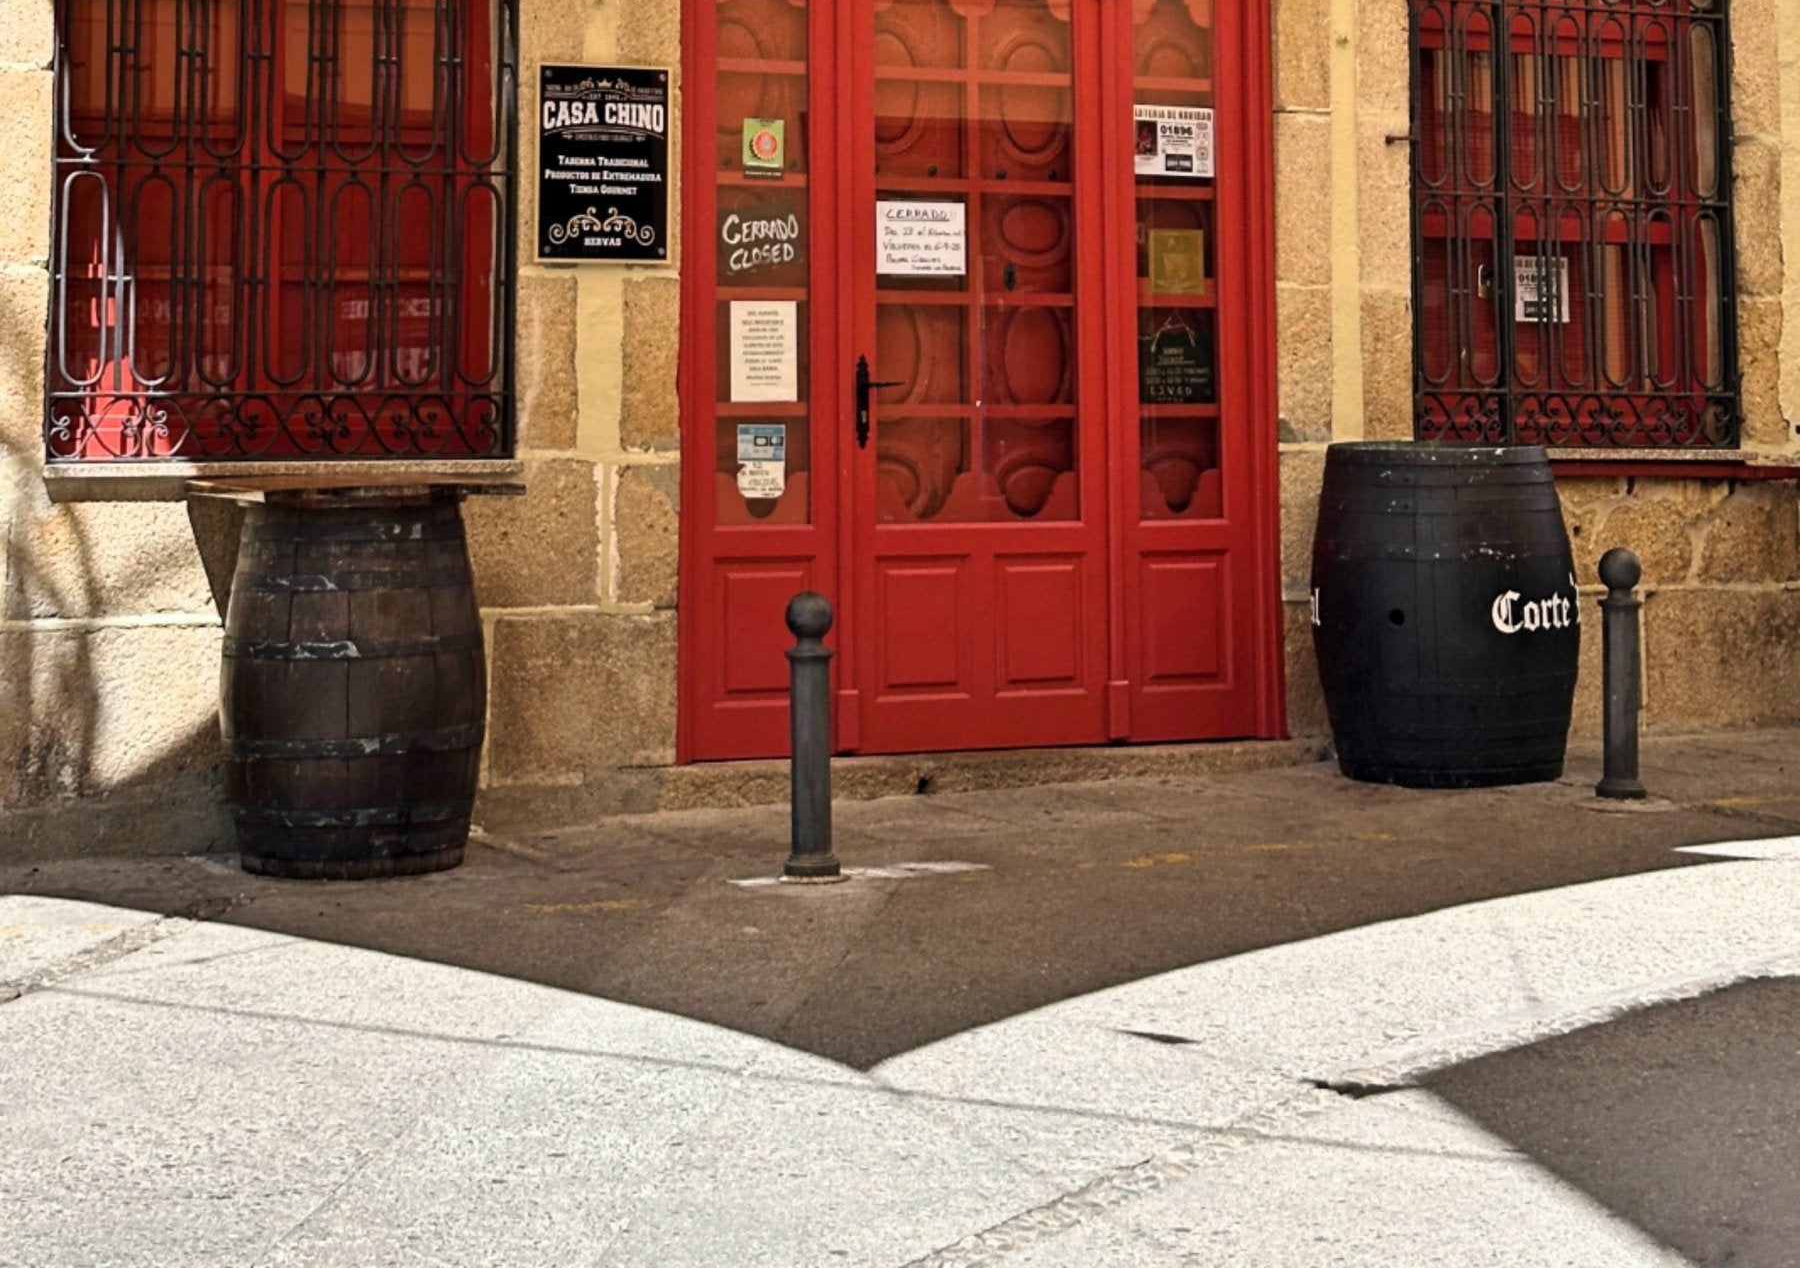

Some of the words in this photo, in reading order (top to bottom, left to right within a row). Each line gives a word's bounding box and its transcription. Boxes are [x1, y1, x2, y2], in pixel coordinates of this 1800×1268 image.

[543, 100, 600, 130] CASA
[604, 102, 665, 133] CHINO
[722, 214, 799, 244] CERRADO
[730, 243, 794, 271] CLOSED
[1491, 589, 1571, 633] Corte
